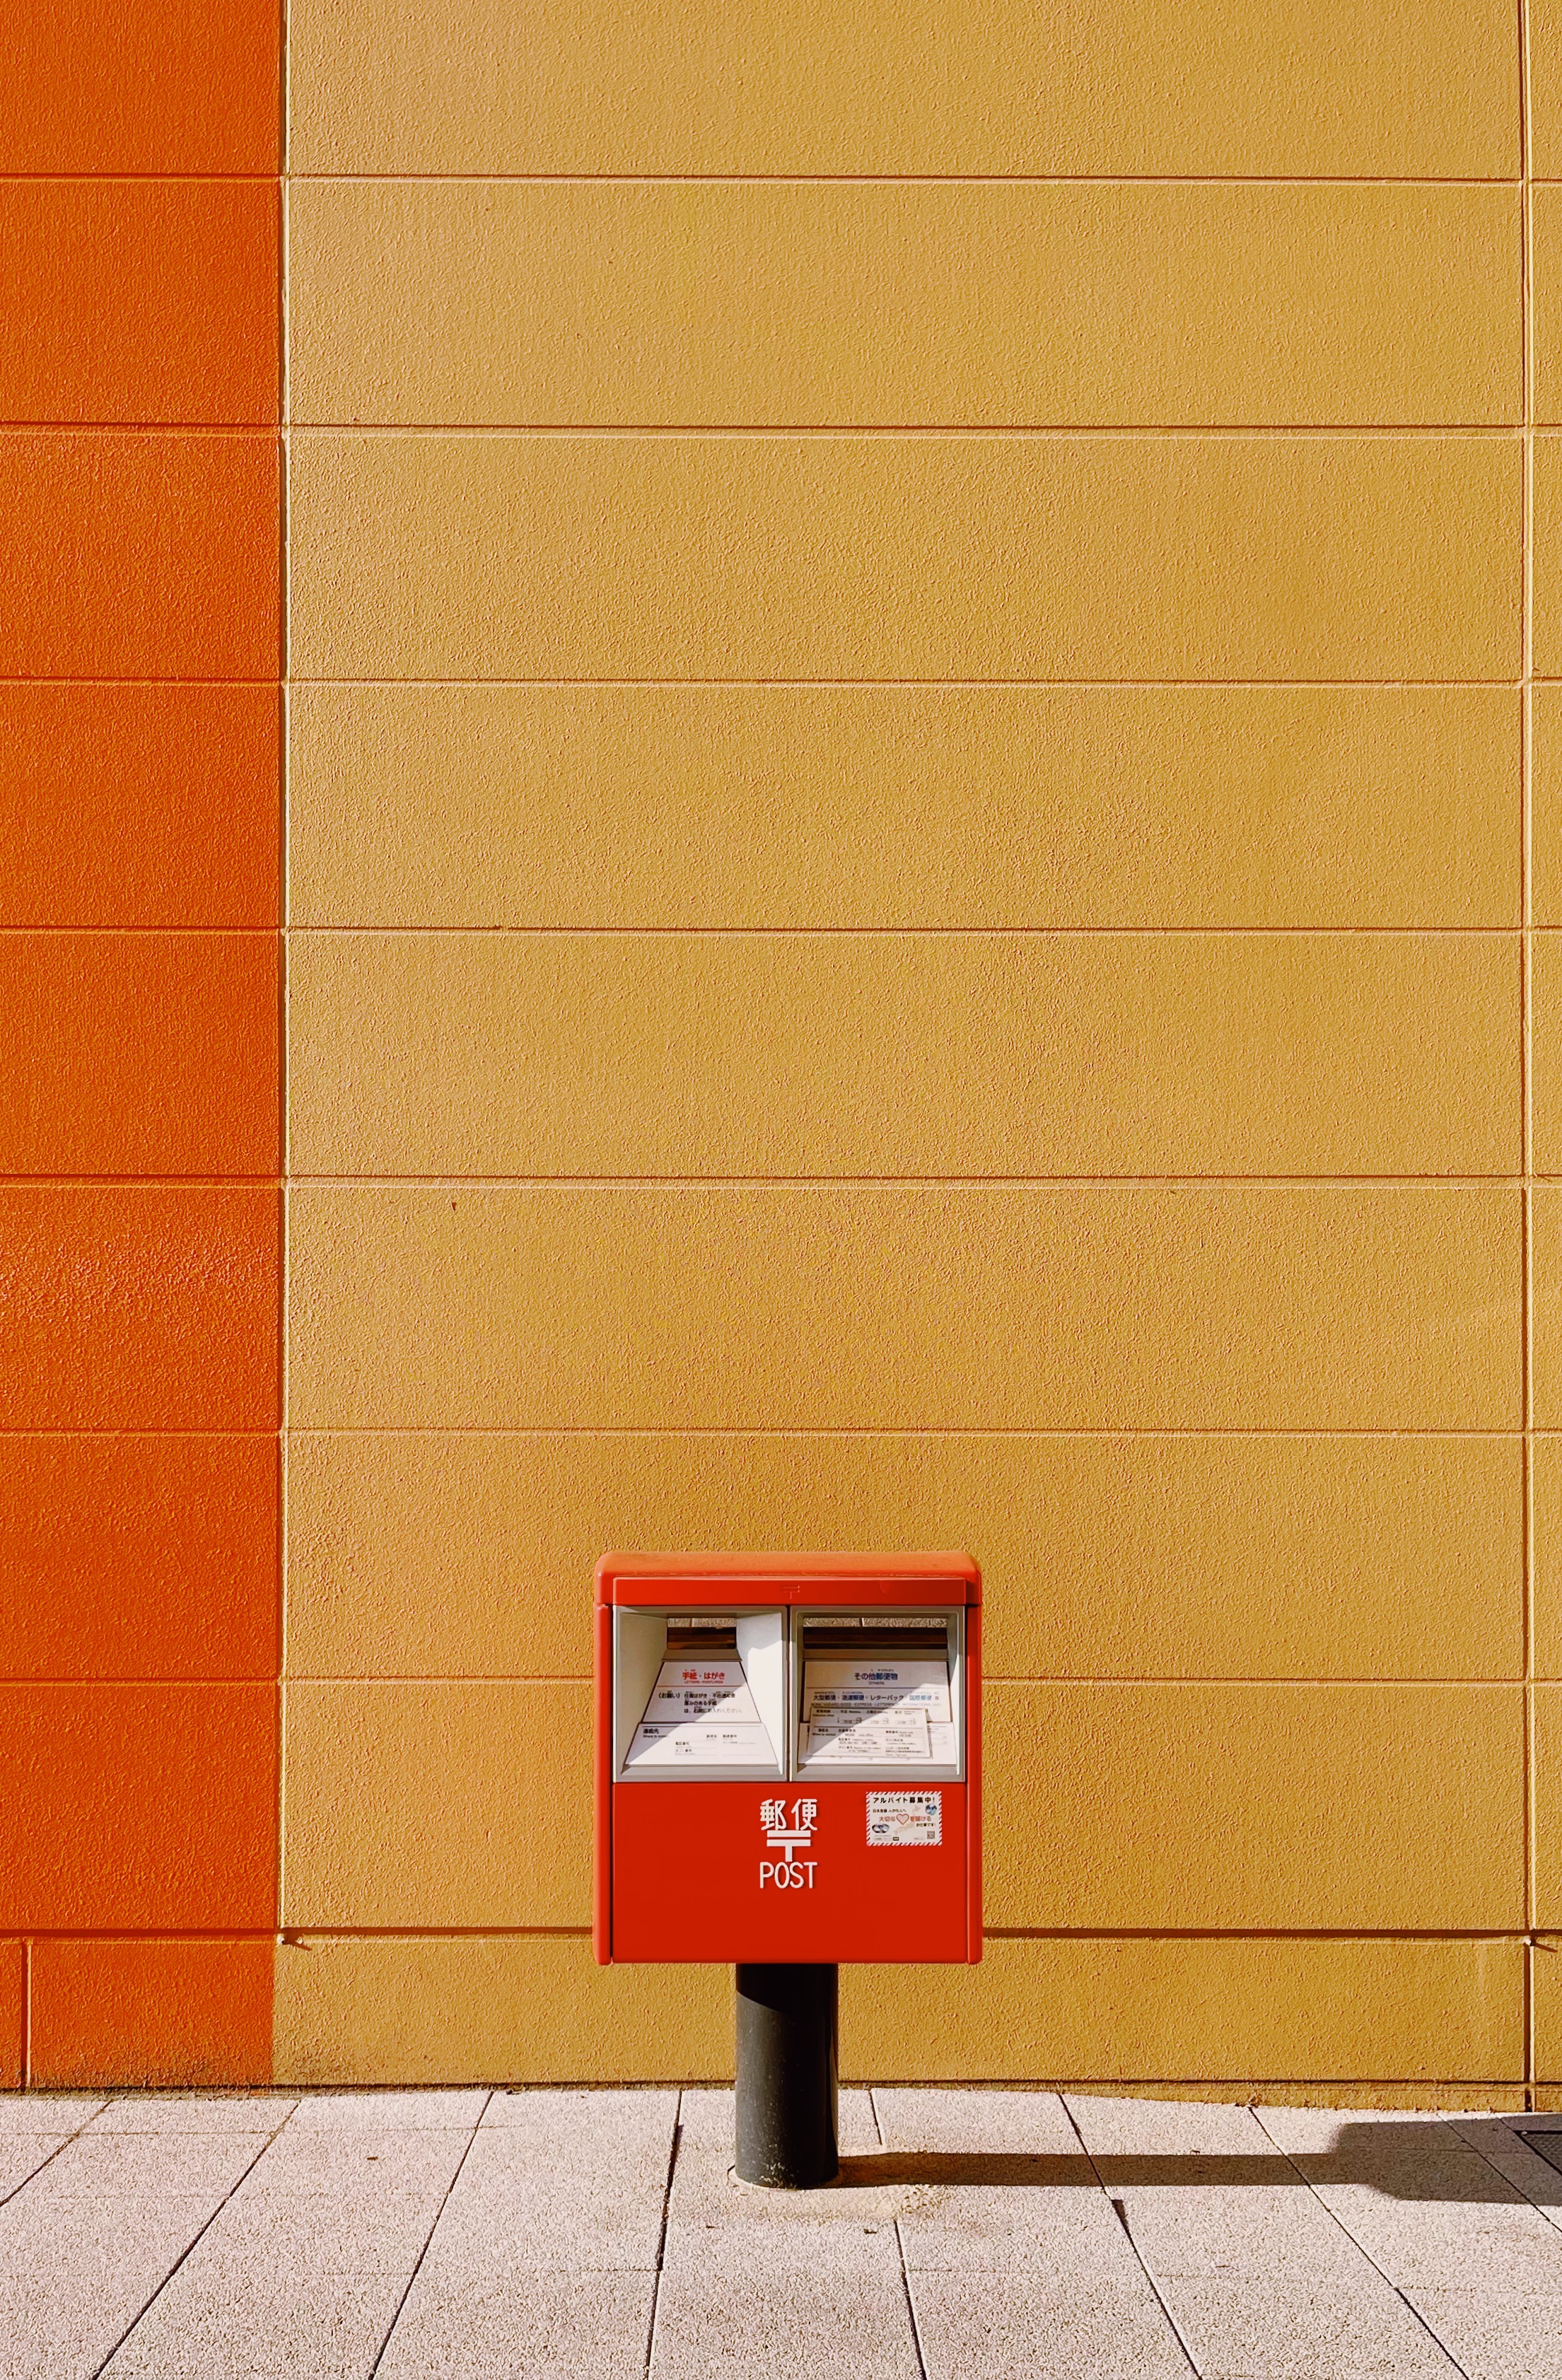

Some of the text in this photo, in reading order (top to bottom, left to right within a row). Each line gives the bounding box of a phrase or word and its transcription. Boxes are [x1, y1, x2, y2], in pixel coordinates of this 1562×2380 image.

[682, 1672, 725, 1680] 手紙・はがき
[854, 1672, 898, 1681] その他郵便物
[759, 1798, 818, 1831] 郵便
[759, 1861, 818, 1889] POST
